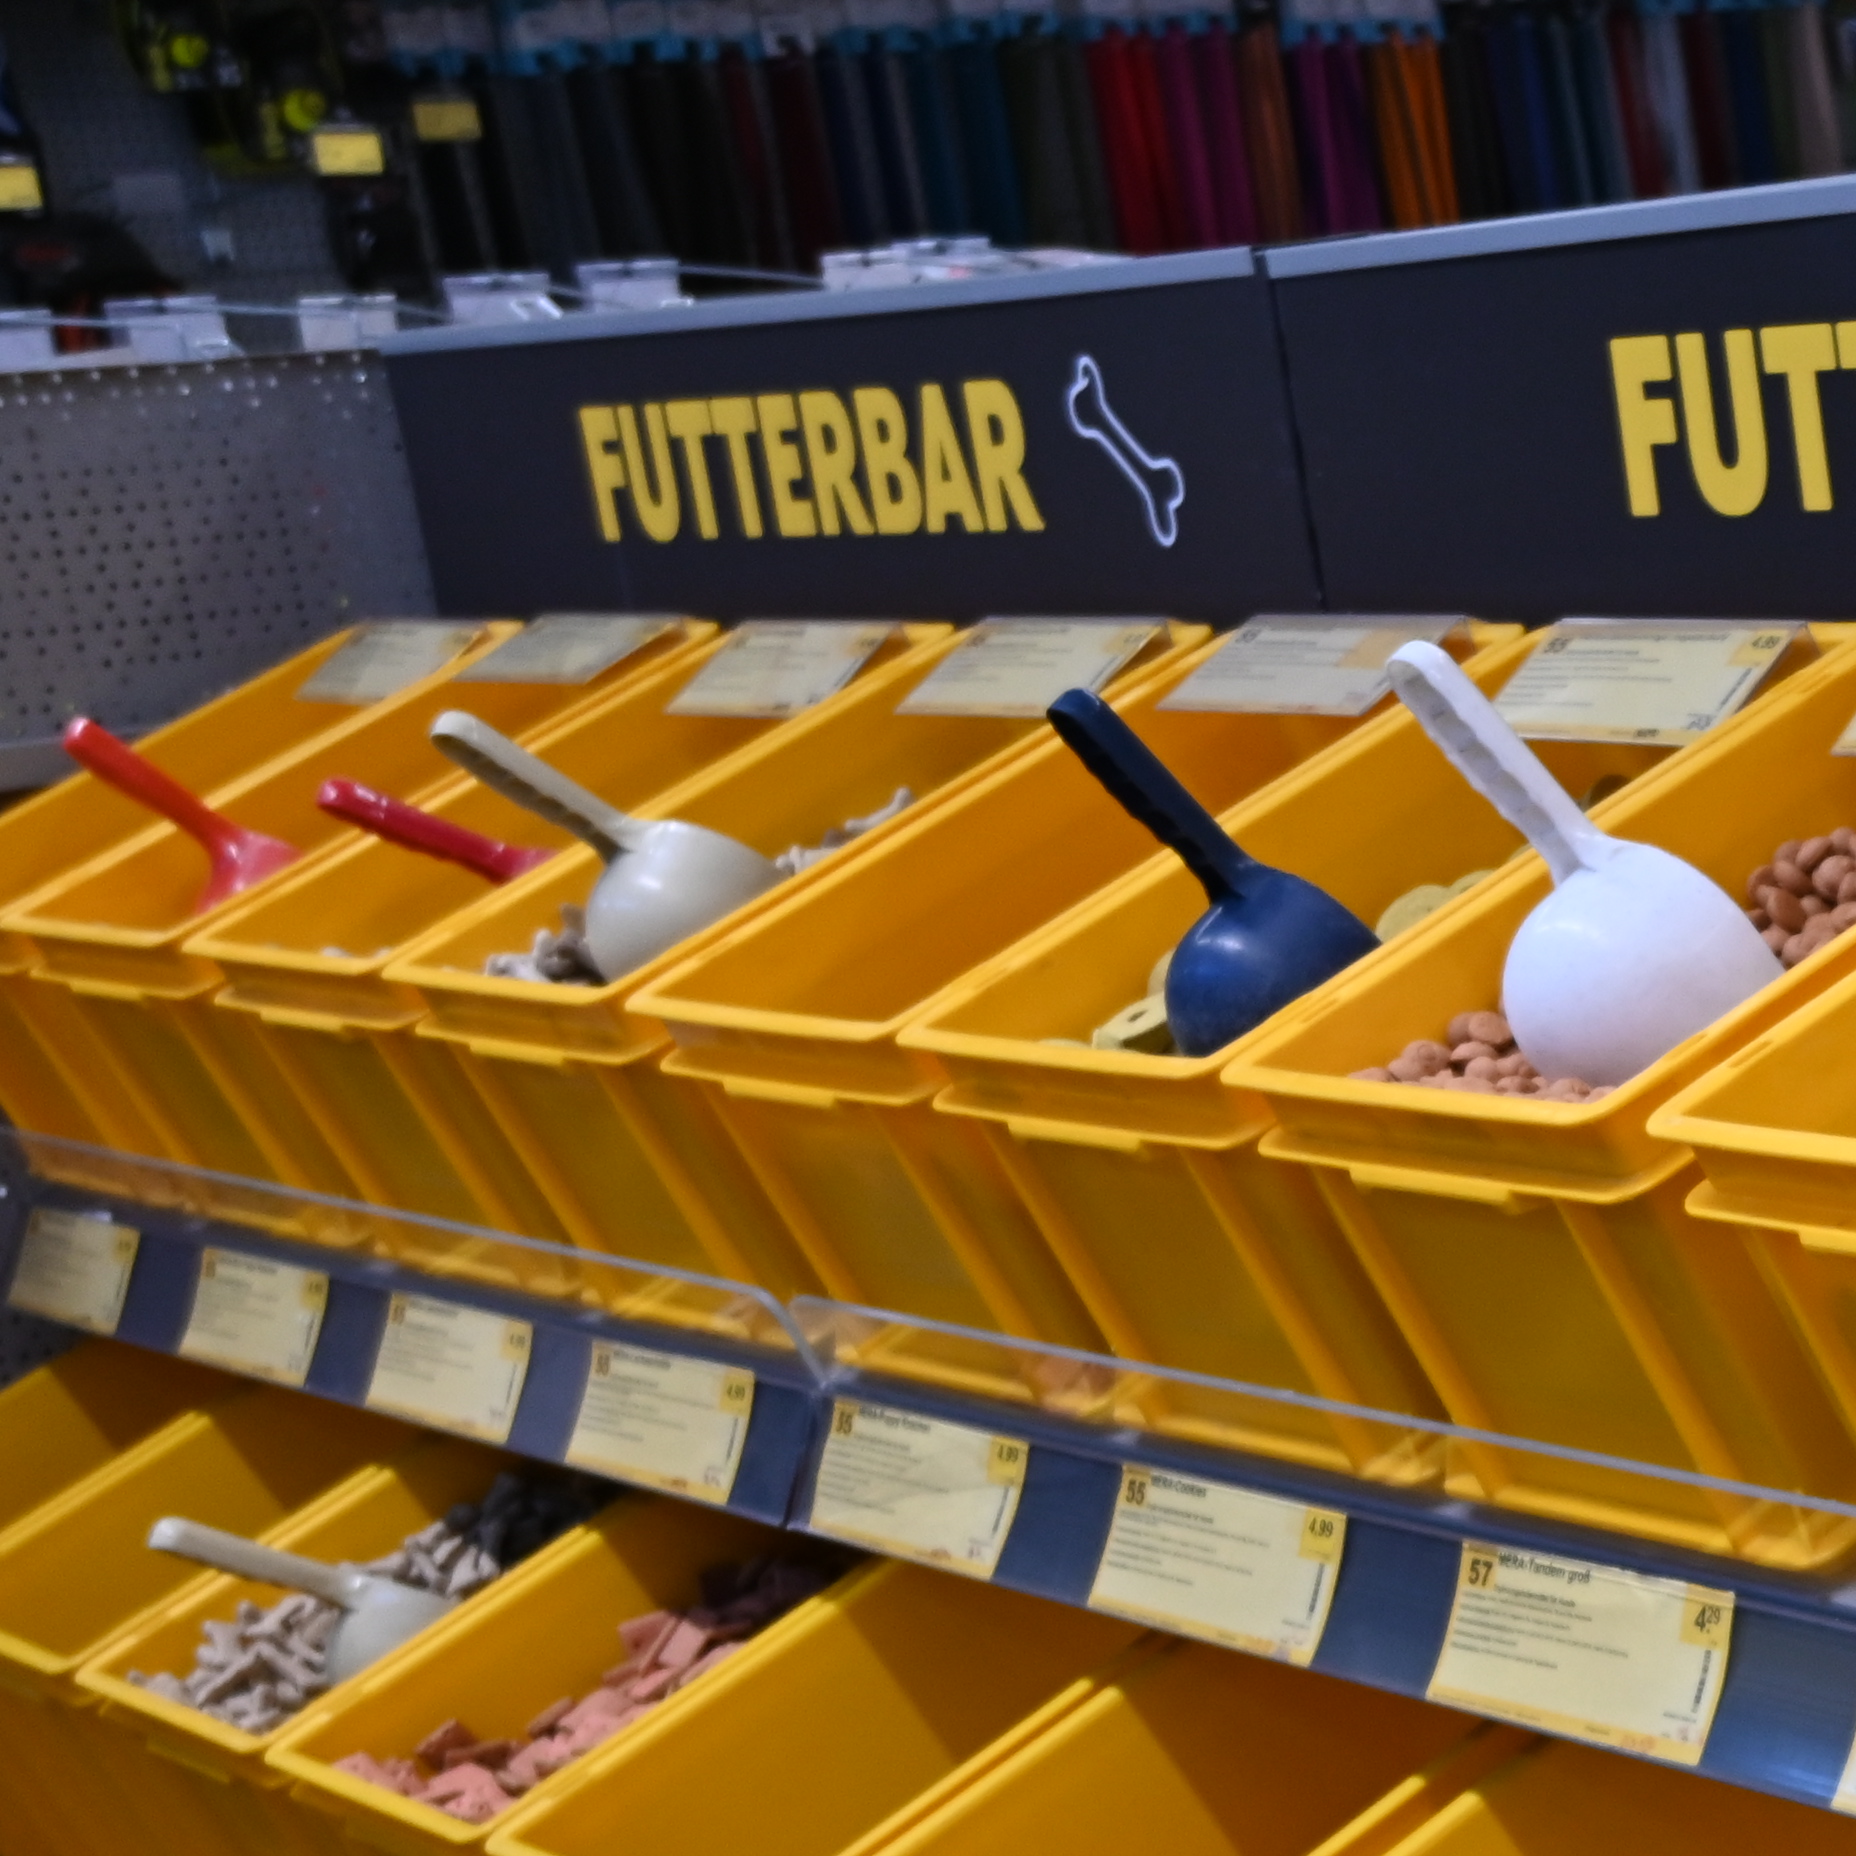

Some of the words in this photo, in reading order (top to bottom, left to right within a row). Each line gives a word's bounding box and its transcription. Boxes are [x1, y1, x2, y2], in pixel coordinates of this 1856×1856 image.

[579, 379, 1045, 543] FUTTERBAR
[1126, 1480, 1146, 1505] 55
[1468, 1559, 1493, 1586] 57
[1567, 1569, 1591, 1584] groß
[1694, 1606, 1721, 1634] 4.29
